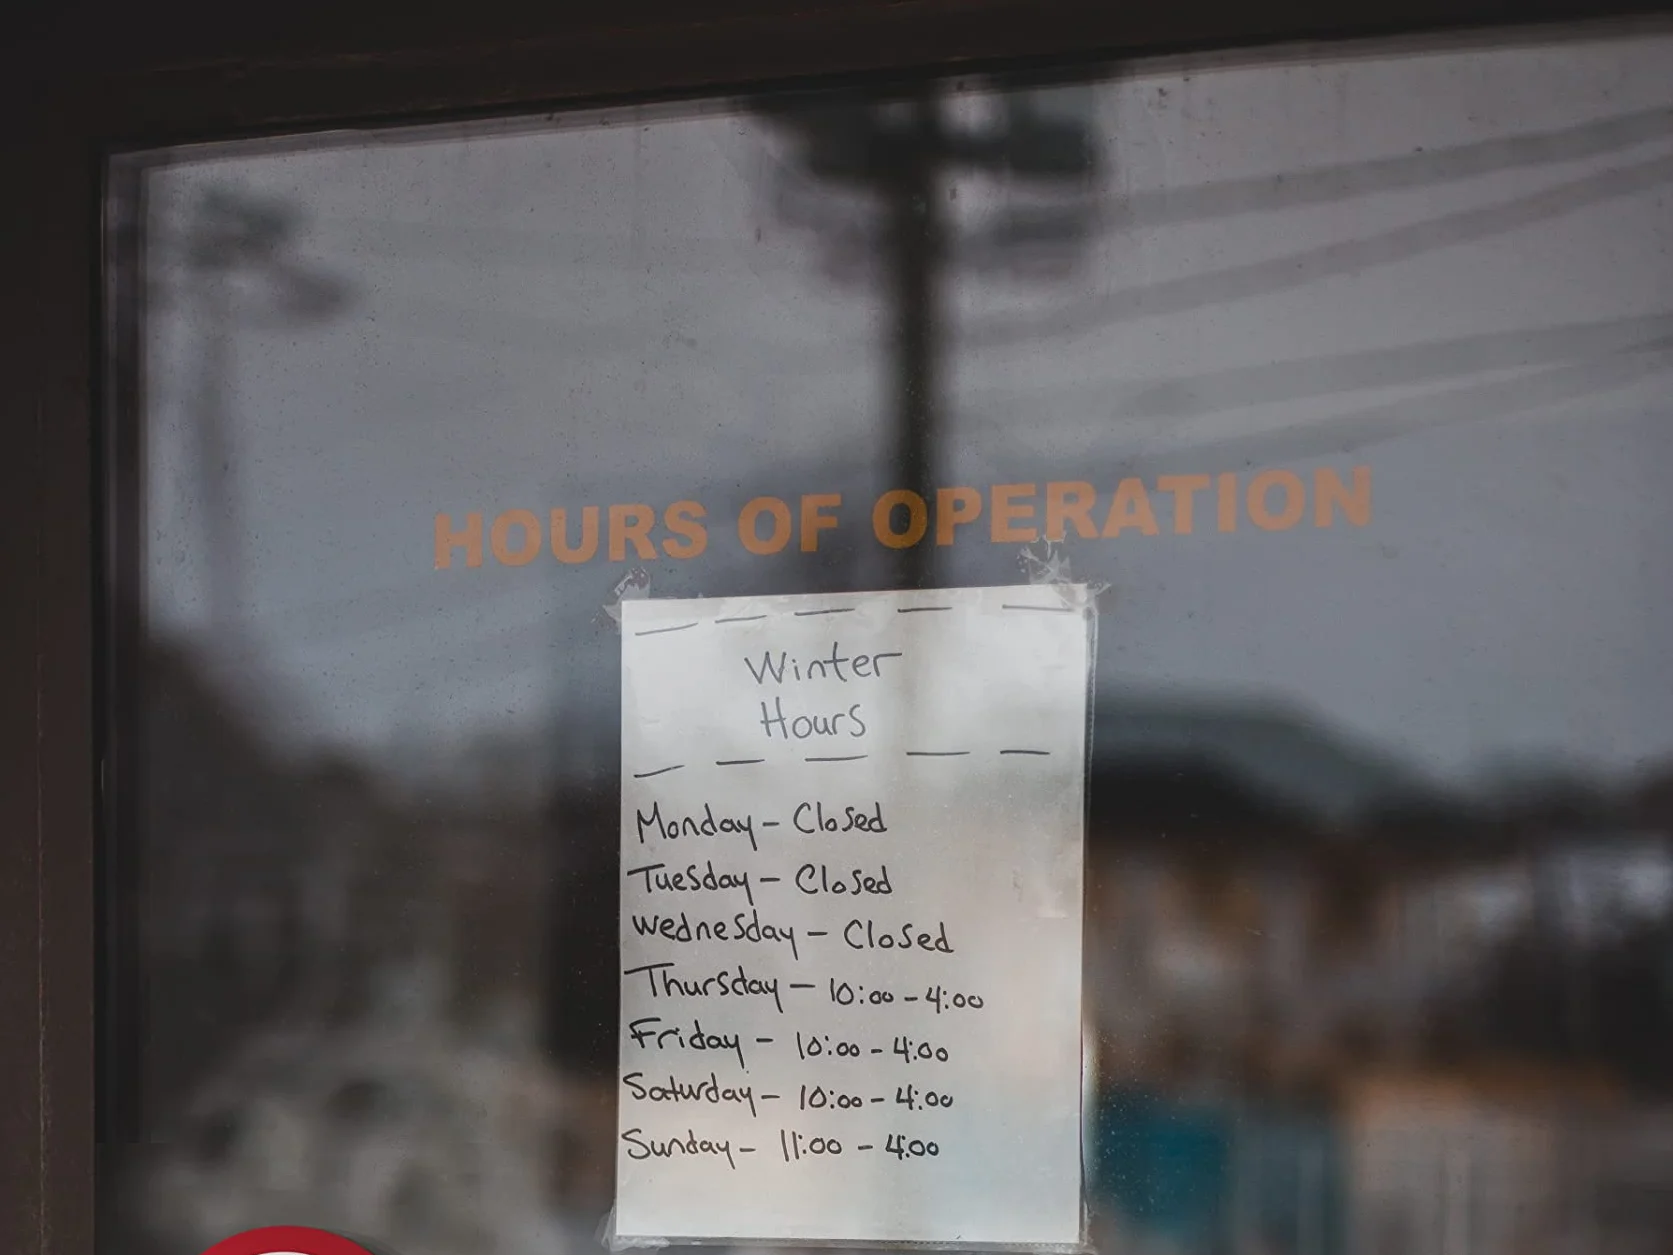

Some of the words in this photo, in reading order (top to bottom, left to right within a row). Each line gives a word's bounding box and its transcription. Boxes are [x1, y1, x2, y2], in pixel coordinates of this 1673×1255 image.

[434, 499, 708, 569] HOURS
[737, 492, 843, 556] OF
[871, 467, 1371, 551] OPERATION
[743, 640, 903, 685] Winter
[759, 696, 866, 740] Hours
[792, 800, 888, 835] Closed
[794, 863, 894, 896] Closed
[843, 918, 955, 954] Closed
[829, 977, 895, 1006] 10:00
[924, 984, 985, 1015] 4:00
[796, 1030, 861, 1061] 10:00
[892, 1035, 949, 1064] 4:00
[799, 1084, 863, 1111] 10:00
[895, 1084, 954, 1111] 4:00
[780, 1128, 843, 1163] 11:00
[884, 1133, 940, 1161] 4:00
